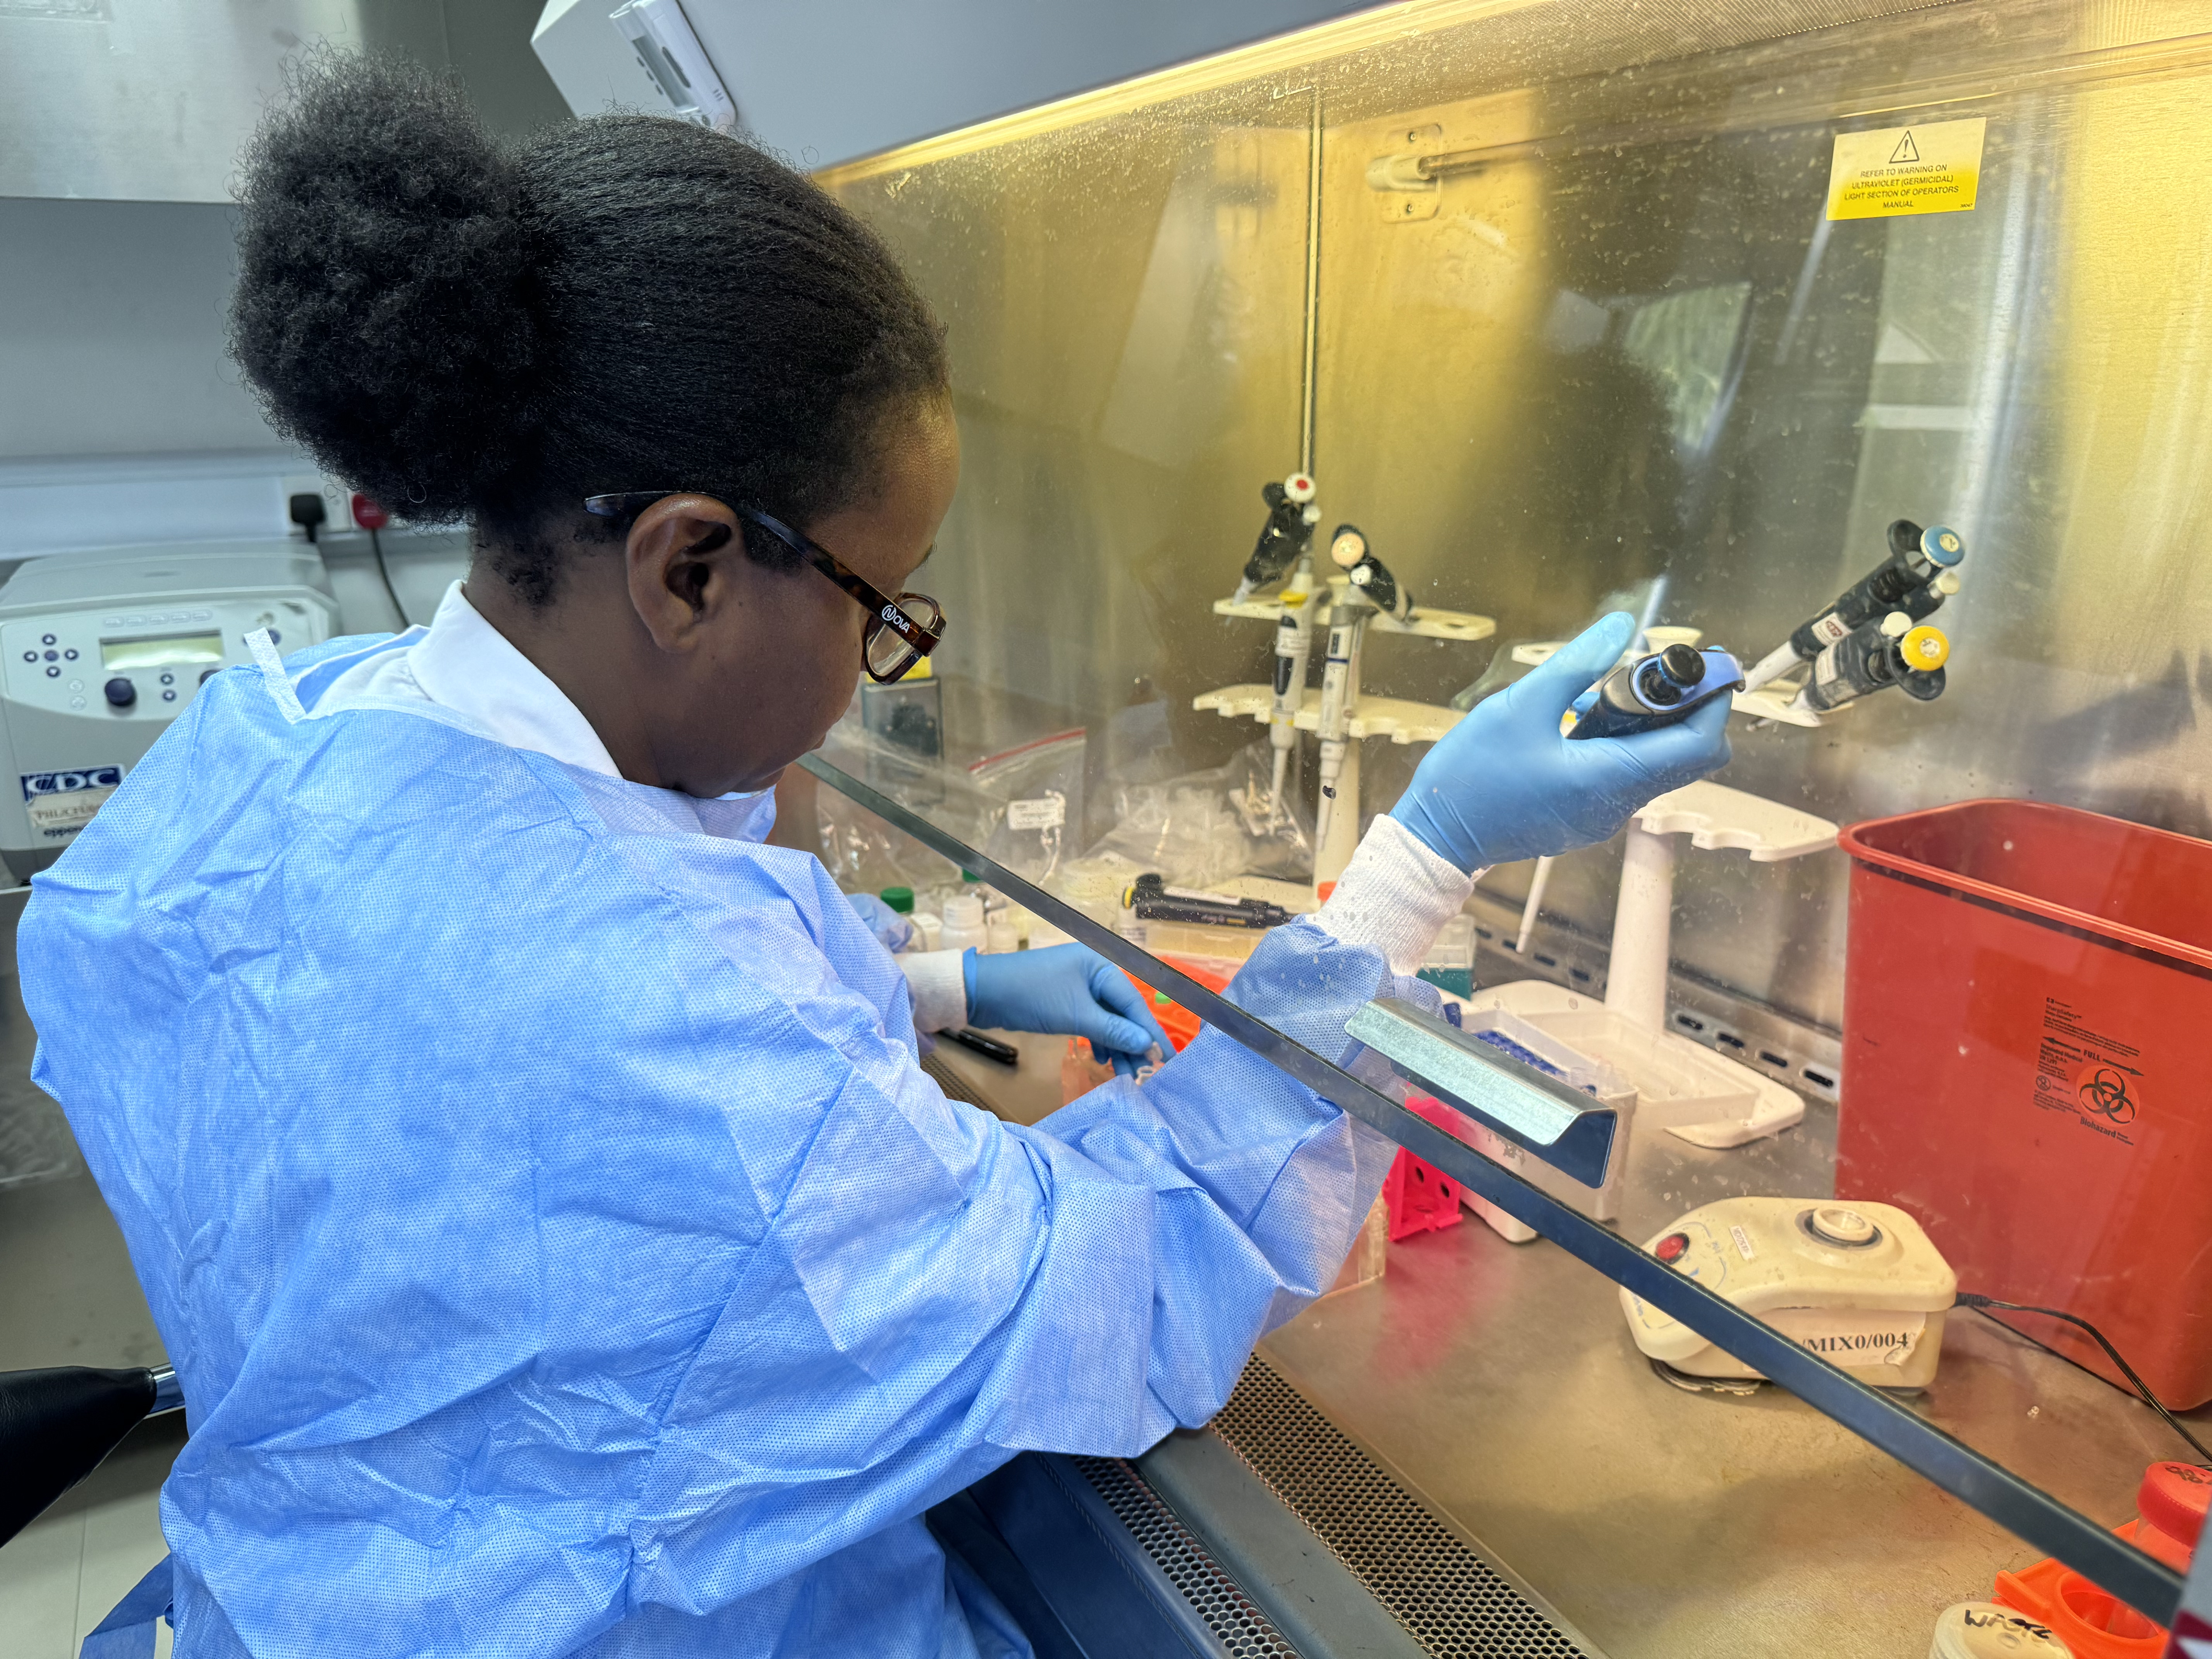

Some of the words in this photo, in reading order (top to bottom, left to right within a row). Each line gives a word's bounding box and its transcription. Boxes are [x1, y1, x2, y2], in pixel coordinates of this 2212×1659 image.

[1860, 169, 1884, 177] REFER
[1886, 168, 1896, 176] TO
[1898, 165, 1933, 174] WARNING
[1852, 179, 1900, 189] ULTRAVIOLET
[1901, 175, 1954, 187] (GERMICIDAL)
[1844, 192, 1866, 200] LIGHT
[1867, 191, 1898, 199] SECTION
[1912, 185, 1959, 194] OPERATORS
[1883, 200, 1914, 208] MANUAL
[26, 768, 118, 793] CDC
[2083, 1049, 2101, 1062] FULL
[2080, 1114, 2116, 1139] Biohazard
